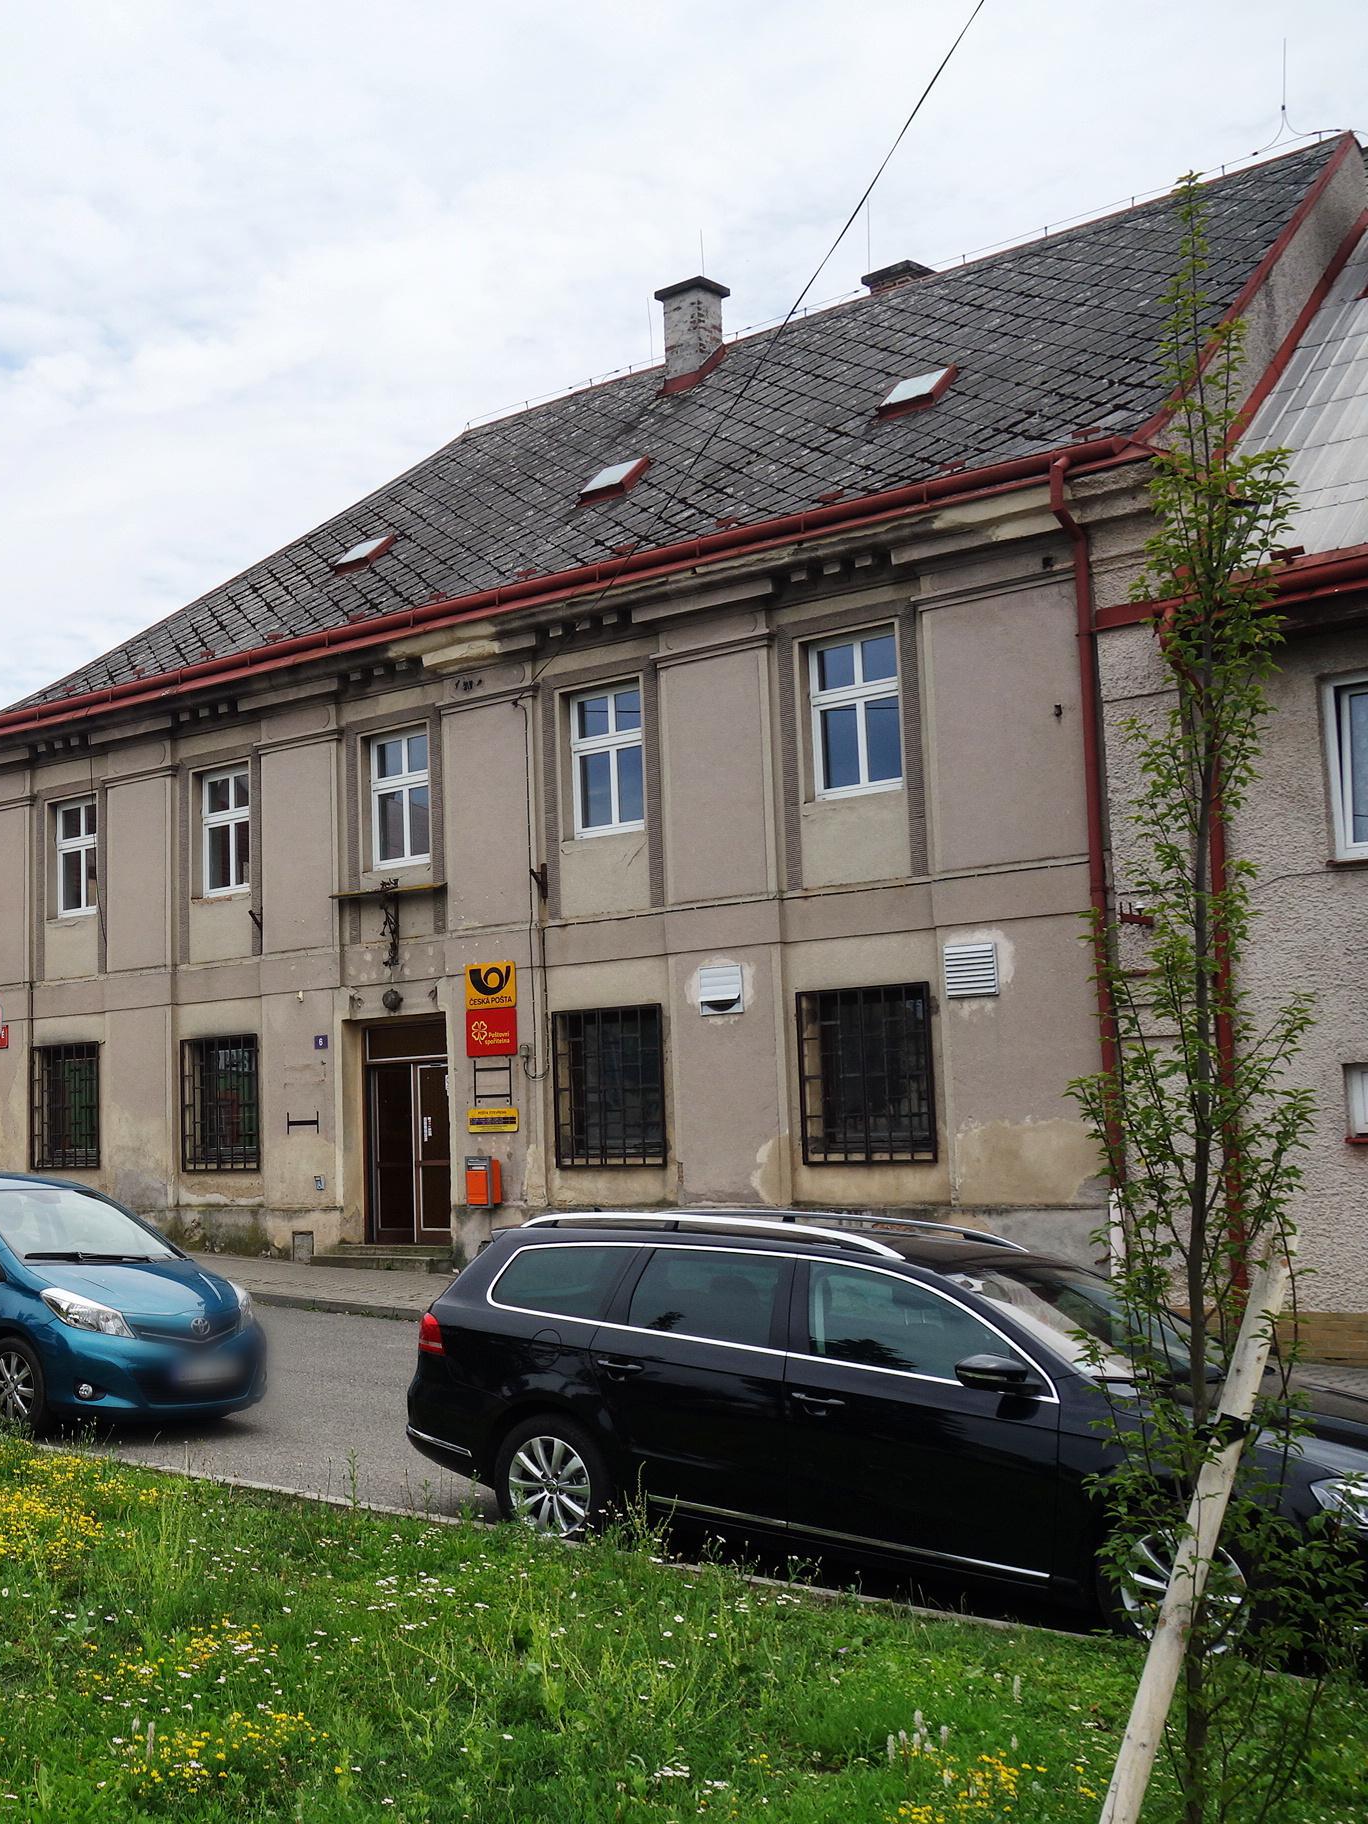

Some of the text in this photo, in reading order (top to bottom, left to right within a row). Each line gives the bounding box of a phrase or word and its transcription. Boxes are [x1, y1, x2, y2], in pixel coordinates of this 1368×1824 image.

[469, 995, 513, 1006] ČESKÁ POŠTA
[318, 1037, 324, 1046] 6
